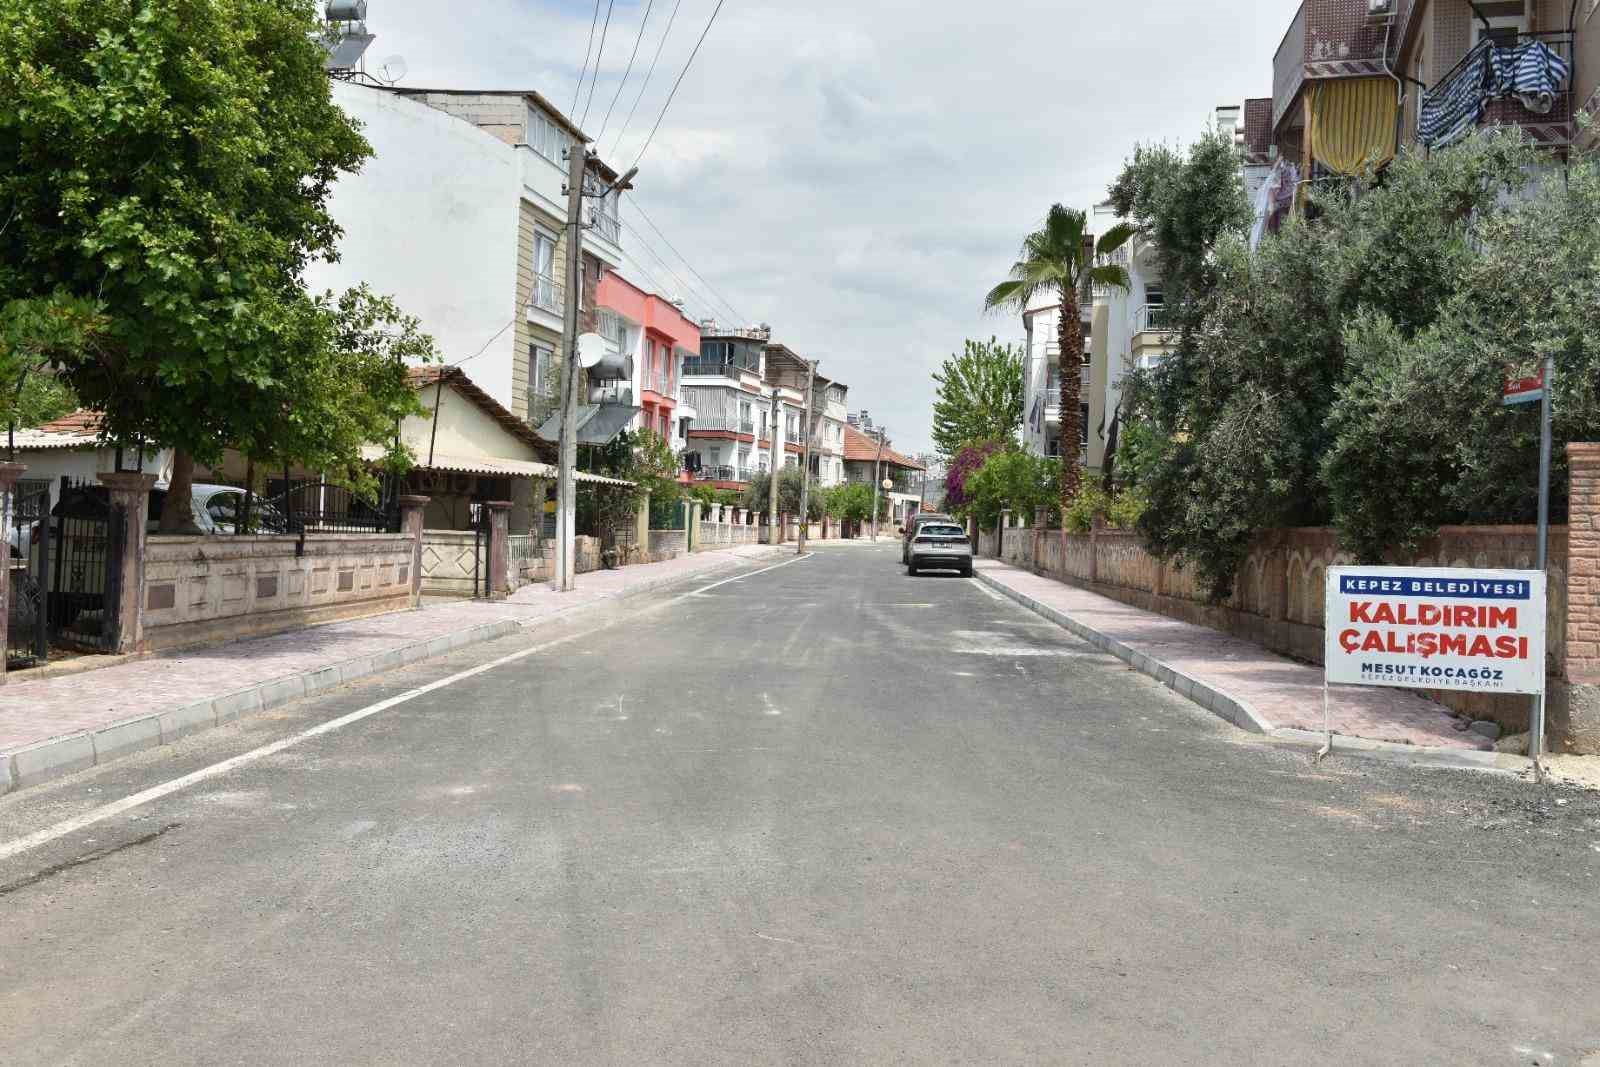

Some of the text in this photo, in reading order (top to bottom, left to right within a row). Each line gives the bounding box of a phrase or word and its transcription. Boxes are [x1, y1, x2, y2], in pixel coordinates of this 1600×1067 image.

[1346, 580, 1523, 594] KEPEZ BELEDİYESİ
[1350, 602, 1517, 628] KALDIRIM
[1339, 629, 1528, 659] ÇALIŞMASI
[1361, 663, 1503, 680] MESUT KOCAGÖZ
